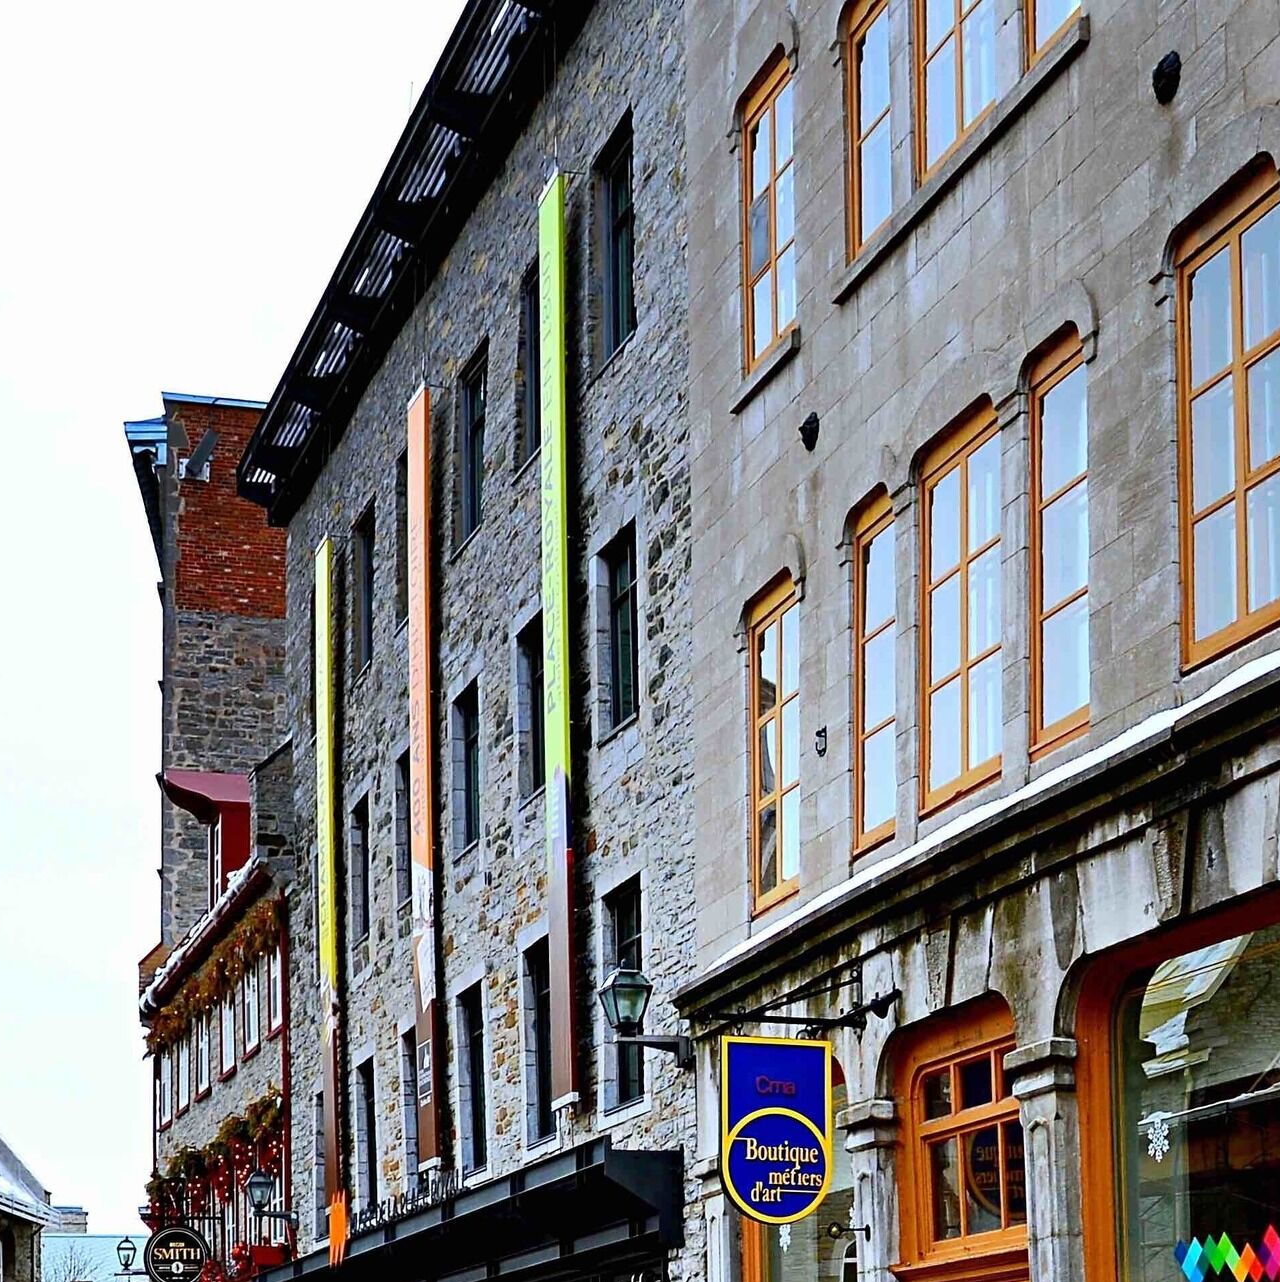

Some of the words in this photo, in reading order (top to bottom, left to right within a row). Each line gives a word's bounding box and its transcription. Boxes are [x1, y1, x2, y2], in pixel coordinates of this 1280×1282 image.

[745, 1138, 818, 1169] Boutique
[768, 1168, 823, 1187] métiers
[750, 1181, 782, 1202] d'art
[153, 1247, 201, 1260] SMITH
